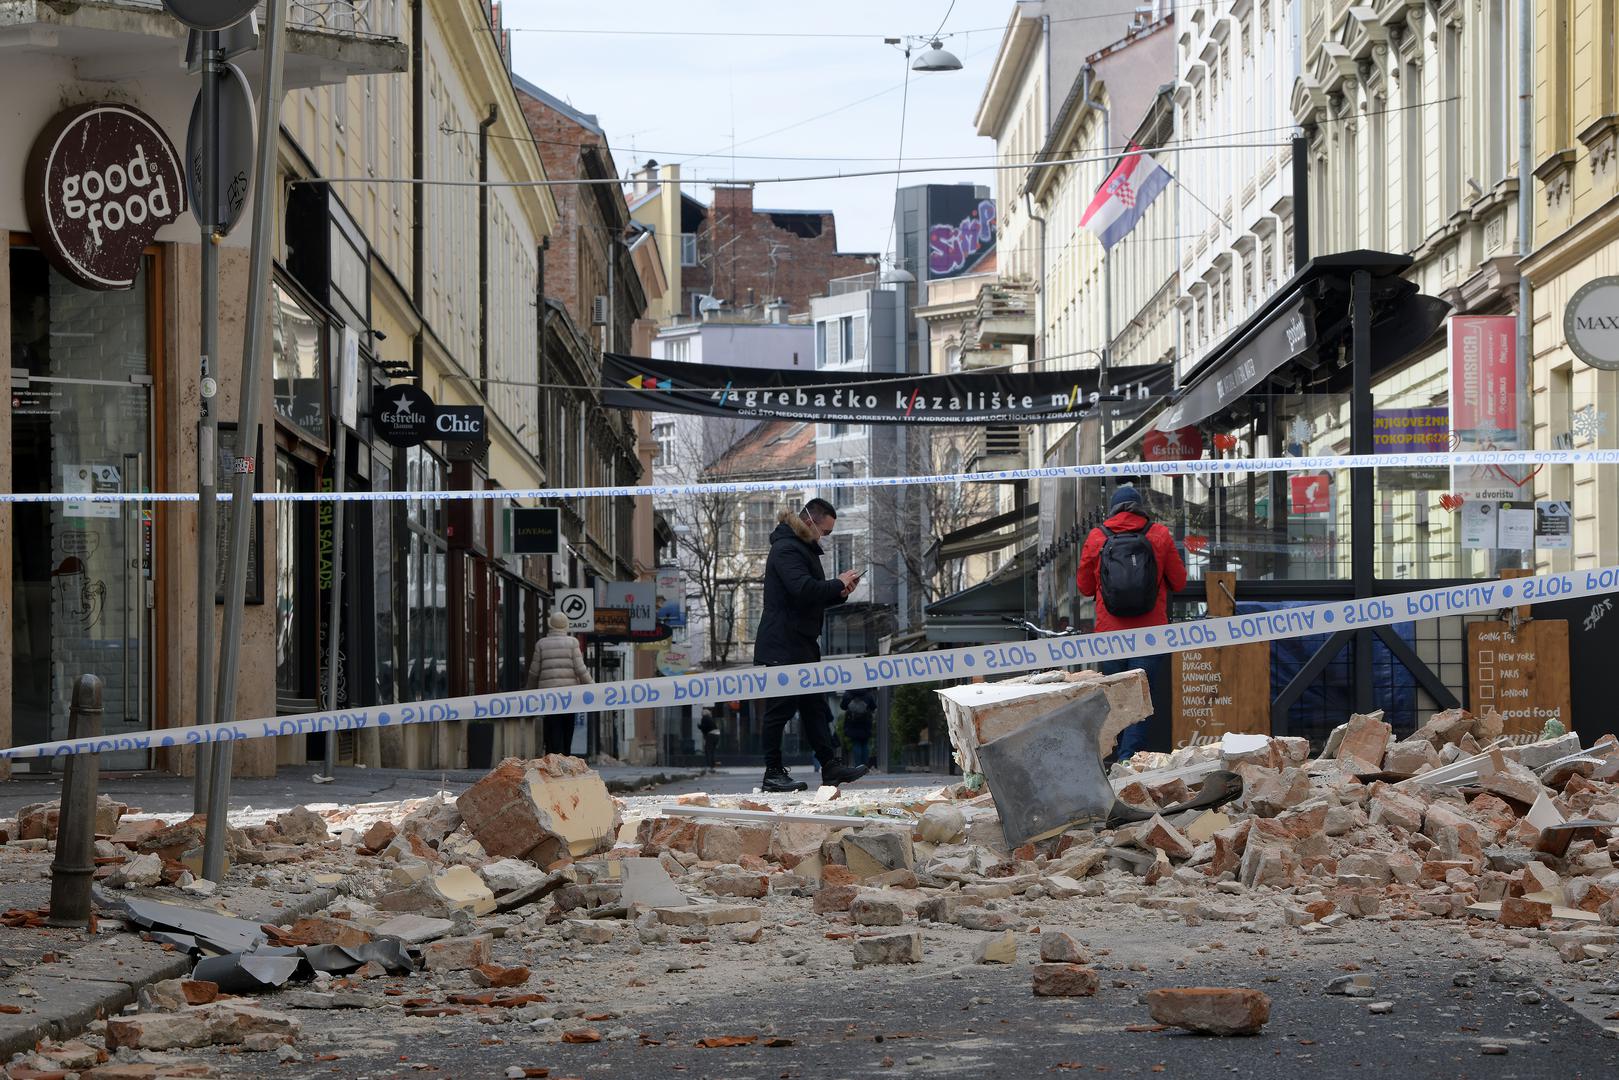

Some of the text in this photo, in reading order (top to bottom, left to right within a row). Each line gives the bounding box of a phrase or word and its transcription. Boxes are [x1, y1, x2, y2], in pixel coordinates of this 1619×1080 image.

[62, 144, 151, 219] good
[88, 174, 171, 246] food
[381, 411, 425, 424] Estrella
[738, 408, 757, 416] ONO
[759, 408, 775, 417] ŠTO
[776, 411, 820, 419] NEDOSTAJE
[965, 414, 1007, 423] SHERLOCK
[1008, 413, 1040, 421] HOLMES
[1046, 411, 1072, 419] ZDRAV
[435, 413, 480, 432] Chic
[1152, 444, 1194, 456] Estrella
[1482, 489, 1514, 499] dvorištu
[320, 529, 333, 591] SALADS
[1478, 631, 1500, 642] GOING
[1182, 652, 1202, 661] SALAD
[1498, 653, 1536, 663] NEW YORK
[1182, 662, 1212, 671] BURGERS
[1182, 672, 1222, 682] SANDWICHES
[1500, 669, 1519, 679] PARIS
[1500, 688, 1528, 698] LONDON
[1182, 696, 1206, 706] SNACKS
[1215, 696, 1232, 705] WINE
[1182, 707, 1214, 717] DESSERTS
[1502, 706, 1561, 720] good food
